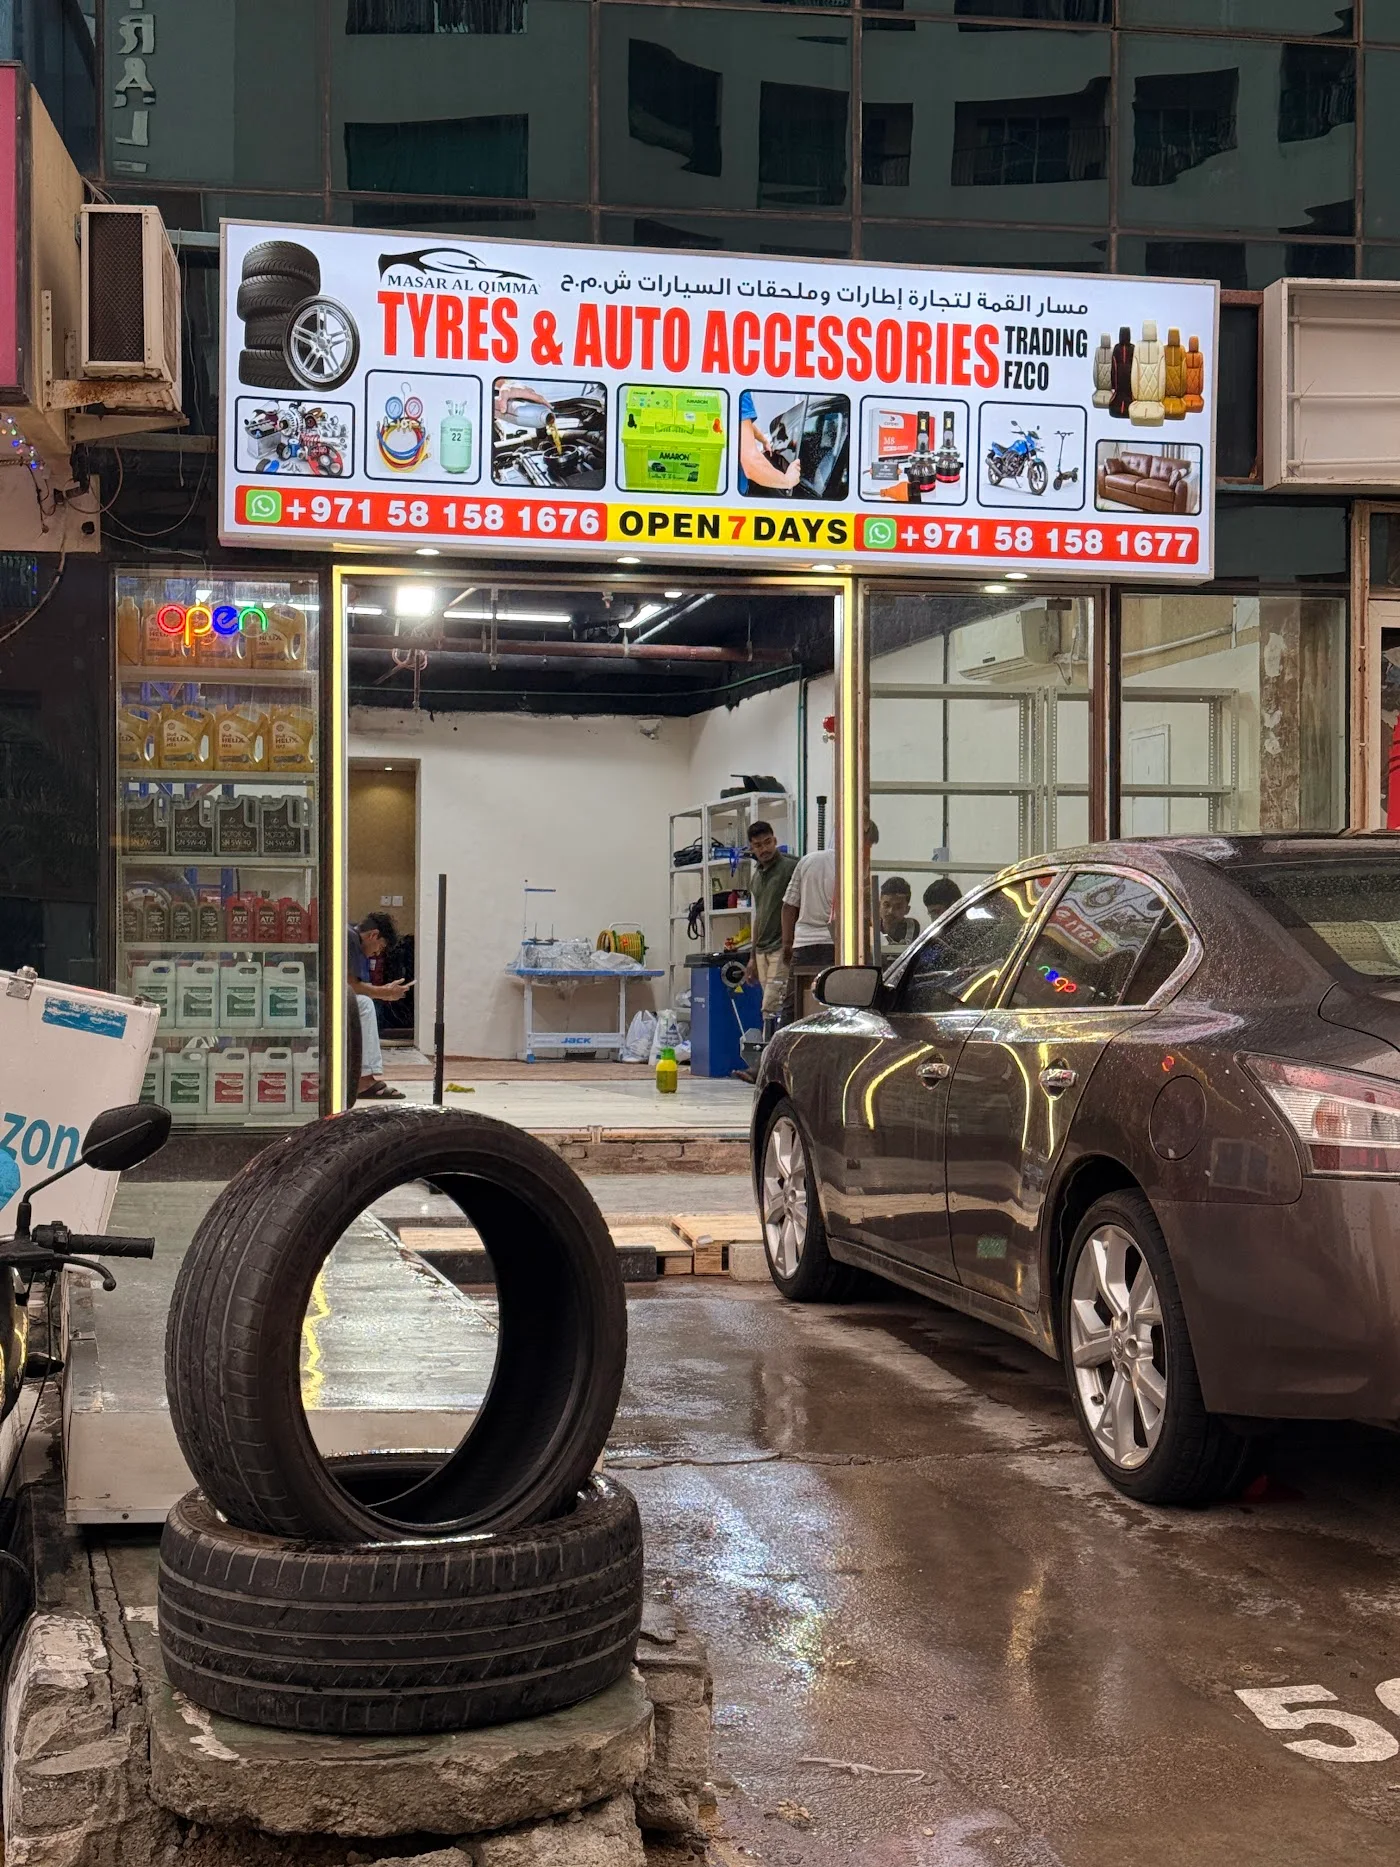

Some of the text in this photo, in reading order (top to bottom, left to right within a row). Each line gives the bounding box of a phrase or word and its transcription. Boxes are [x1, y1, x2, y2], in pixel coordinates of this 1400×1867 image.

[387, 275, 540, 296] MASAR AL QIMMA
[637, 276, 731, 300] السيارات
[738, 279, 831, 306] وملحقات
[836, 285, 902, 310] إطارات
[909, 288, 971, 312] لتجارة
[977, 291, 1031, 313] القمة
[1036, 296, 1088, 318] مسار
[378, 291, 1000, 389] TYRES & AUTO ACCESSORIES
[1004, 325, 1088, 358] TRADING
[1003, 360, 1049, 391] FZCO
[451, 432, 462, 442] 22
[659, 451, 690, 461] AMARON
[286, 498, 600, 535] +971 58 158 1676
[619, 510, 848, 545] OPEN 7 DAYS
[900, 523, 1193, 558] +971 58 158 1677
[157, 603, 268, 647] open
[1233, 1677, 1400, 1763] 5
